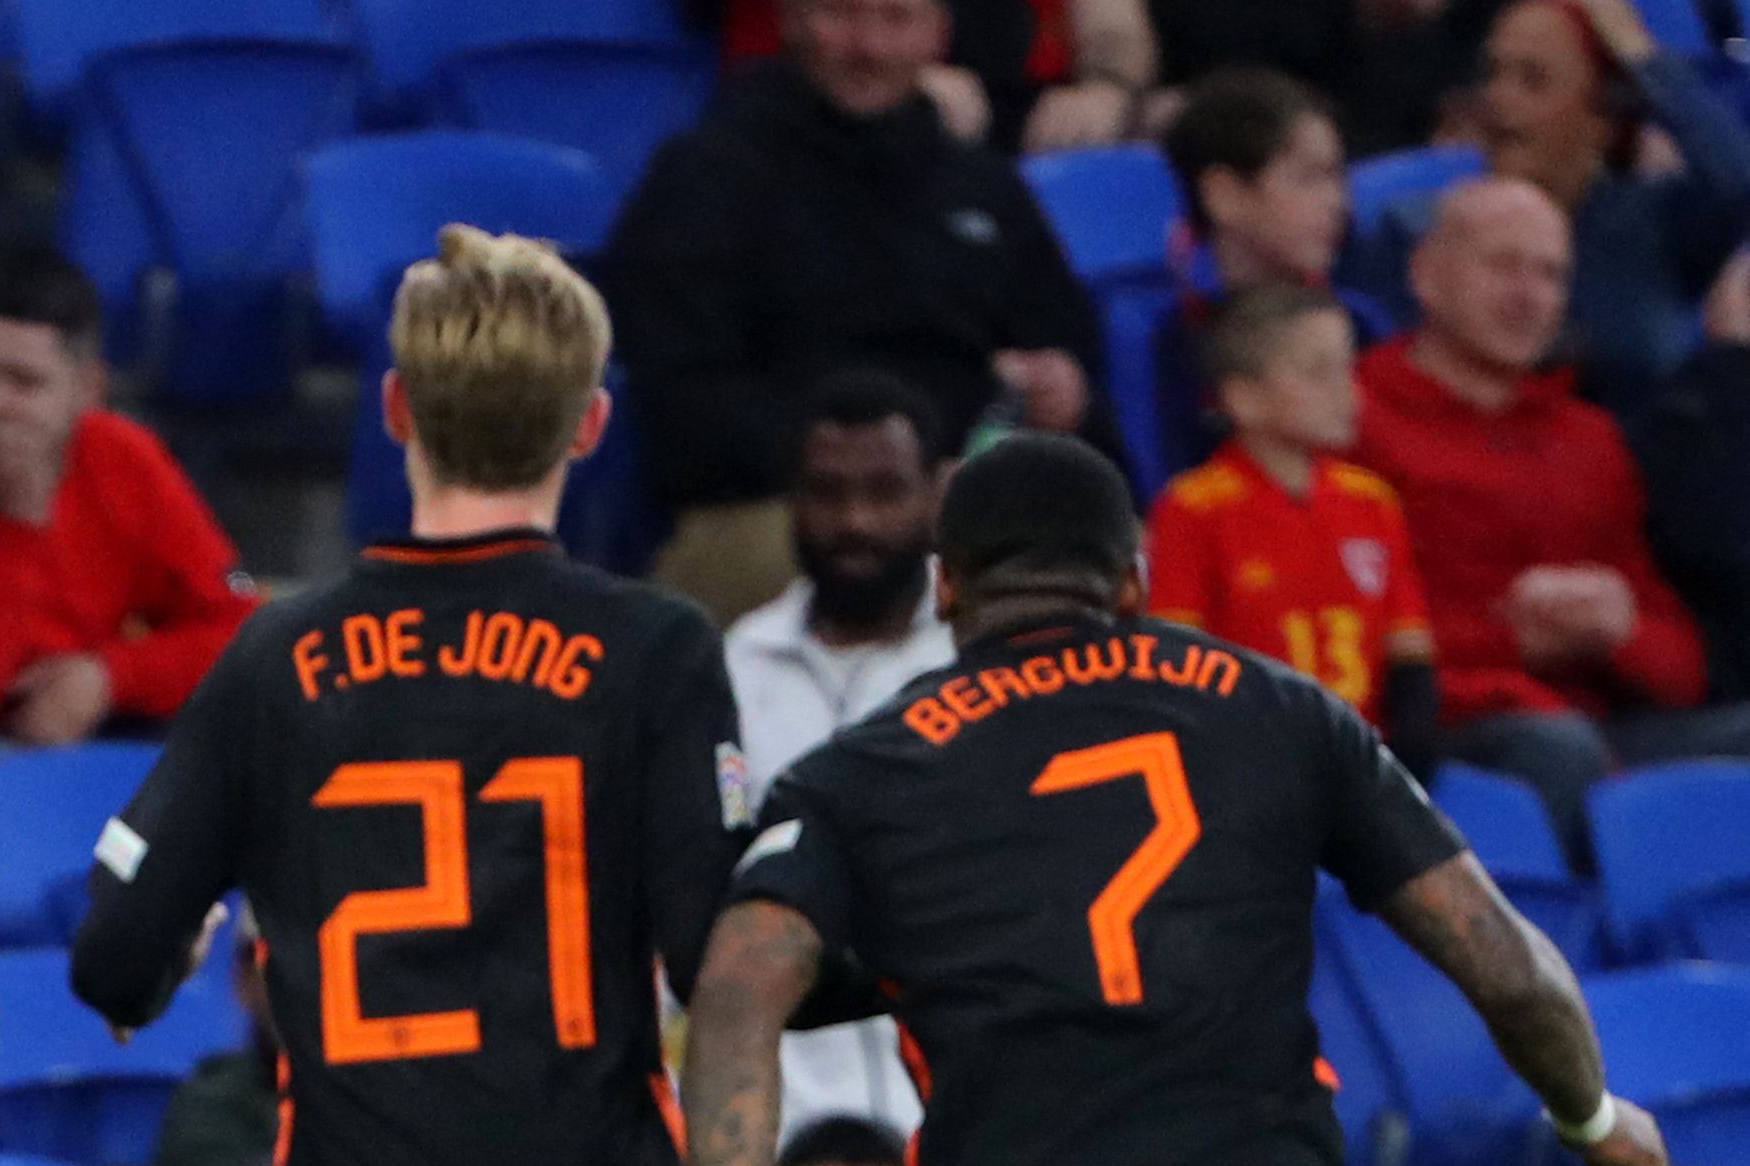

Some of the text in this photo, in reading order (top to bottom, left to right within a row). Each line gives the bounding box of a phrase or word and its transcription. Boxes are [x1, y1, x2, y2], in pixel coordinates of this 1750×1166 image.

[438, 610, 605, 699] JONG
[902, 634, 1243, 745] BERGWIJN
[311, 755, 597, 1065] 21
[1029, 730, 1202, 1006] 7
